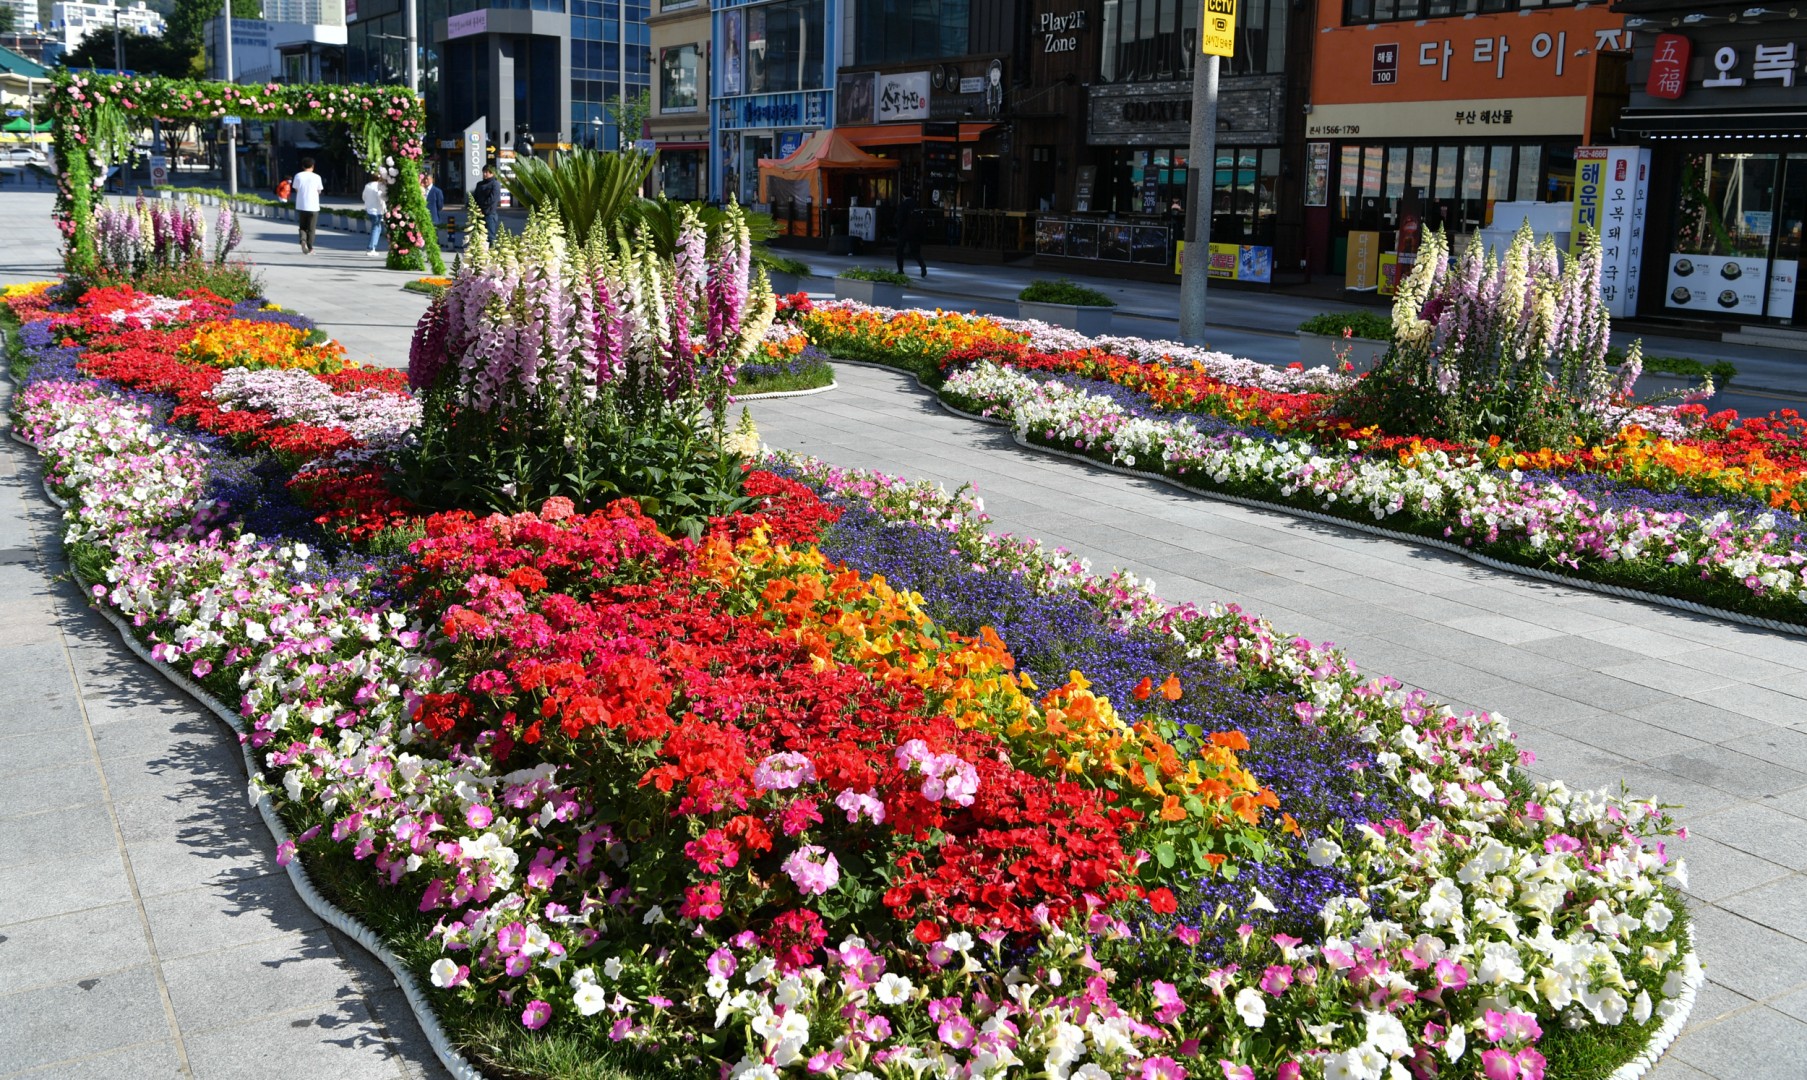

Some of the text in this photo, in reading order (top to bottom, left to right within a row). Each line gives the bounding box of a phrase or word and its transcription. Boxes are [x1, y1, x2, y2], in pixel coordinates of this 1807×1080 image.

[1210, 0, 1232, 13] CCTV
[1045, 34, 1077, 52] Zone
[1377, 51, 1393, 64] 해물
[1702, 42, 1807, 88] 오복
[1655, 40, 1681, 95] 五福
[1377, 72, 1391, 82] 100
[1454, 110, 1513, 125] 부산 해산물
[1323, 125, 1360, 134] 1566-1790
[471, 132, 480, 176] encore
[1578, 163, 1600, 228] 해운대
[1602, 187, 1626, 301] 오복돼지국밥
